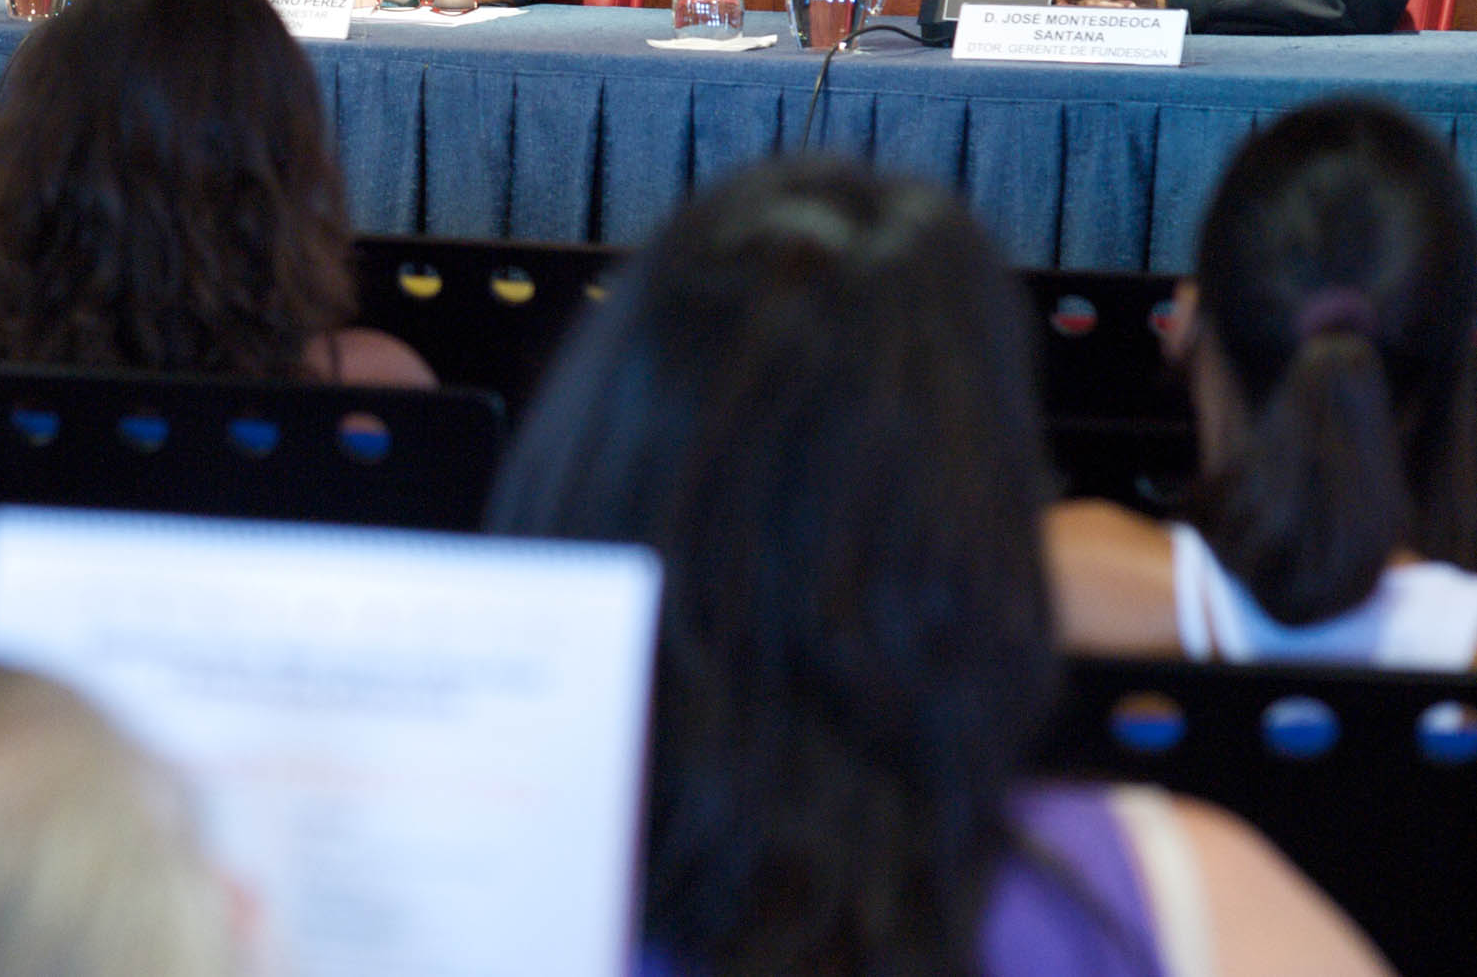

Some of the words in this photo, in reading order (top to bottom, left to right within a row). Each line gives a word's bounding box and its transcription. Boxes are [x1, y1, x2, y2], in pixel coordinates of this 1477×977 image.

[984, 11, 997, 23] D.
[1045, 14, 1161, 28] MONTESDEOCA
[1033, 29, 1105, 42] SANTANA
[1008, 43, 1067, 55] GERENTE
[1070, 45, 1087, 56] DE
[1091, 46, 1169, 59] FUNDESCAN
